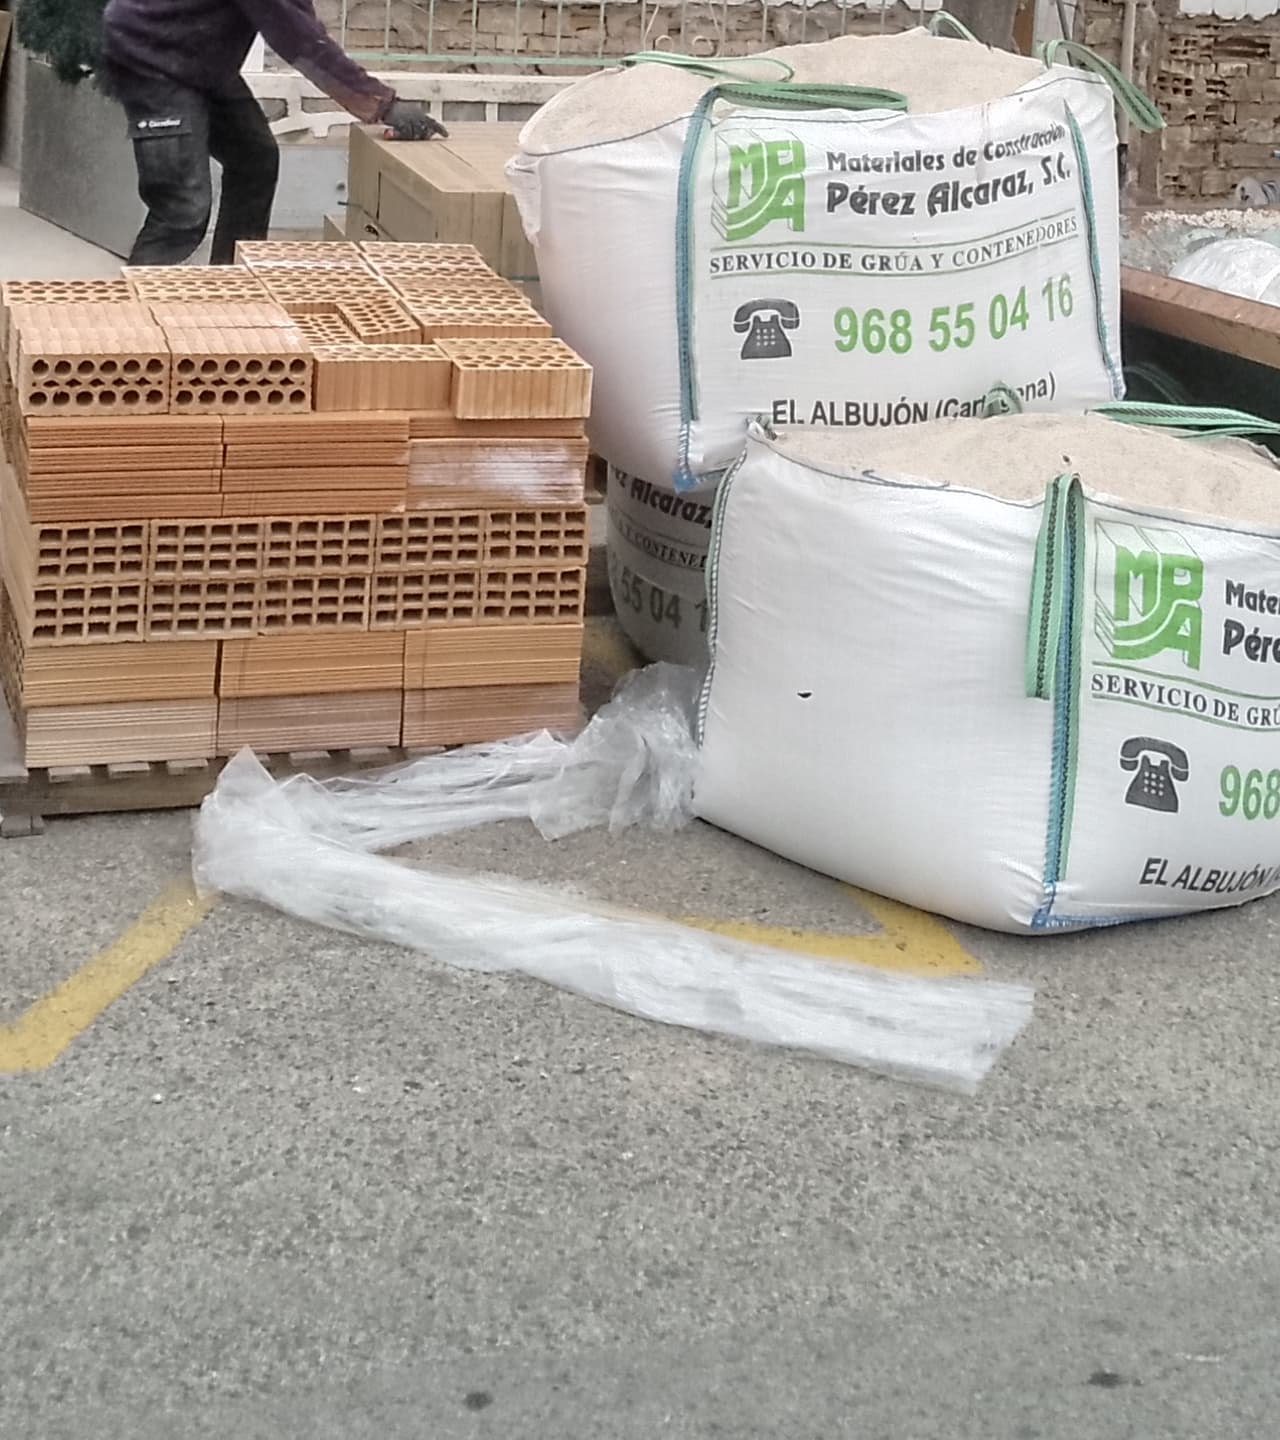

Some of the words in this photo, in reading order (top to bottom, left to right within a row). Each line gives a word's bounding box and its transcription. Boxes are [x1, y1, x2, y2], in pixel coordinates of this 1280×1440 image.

[826, 150, 945, 174] Materiales
[952, 145, 977, 168] de
[826, 181, 917, 217] Pérez
[926, 167, 1036, 218] Alcaraz,
[1041, 151, 1072, 186] S.C.
[709, 250, 817, 275] SERVICIO
[823, 252, 853, 271] DE
[861, 251, 923, 273] GRÚA
[931, 253, 945, 271] Y
[952, 215, 1079, 268] CONTENEDORES
[833, 306, 914, 355] 968
[928, 301, 976, 353] 55
[988, 285, 1030, 340] 04
[1040, 272, 1074, 322] 16
[772, 399, 805, 426] EL
[809, 396, 931, 428] ALBUJÓN
[934, 371, 1057, 422] (Cartna)
[630, 477, 713, 529] Alcaraz,
[620, 566, 644, 614] 55
[649, 584, 683, 629] 04
[1091, 673, 1208, 713] SERVICIO
[1213, 698, 1240, 723] DE
[1139, 857, 1169, 886] EL
[1170, 863, 1273, 894] ALBUJÓN
